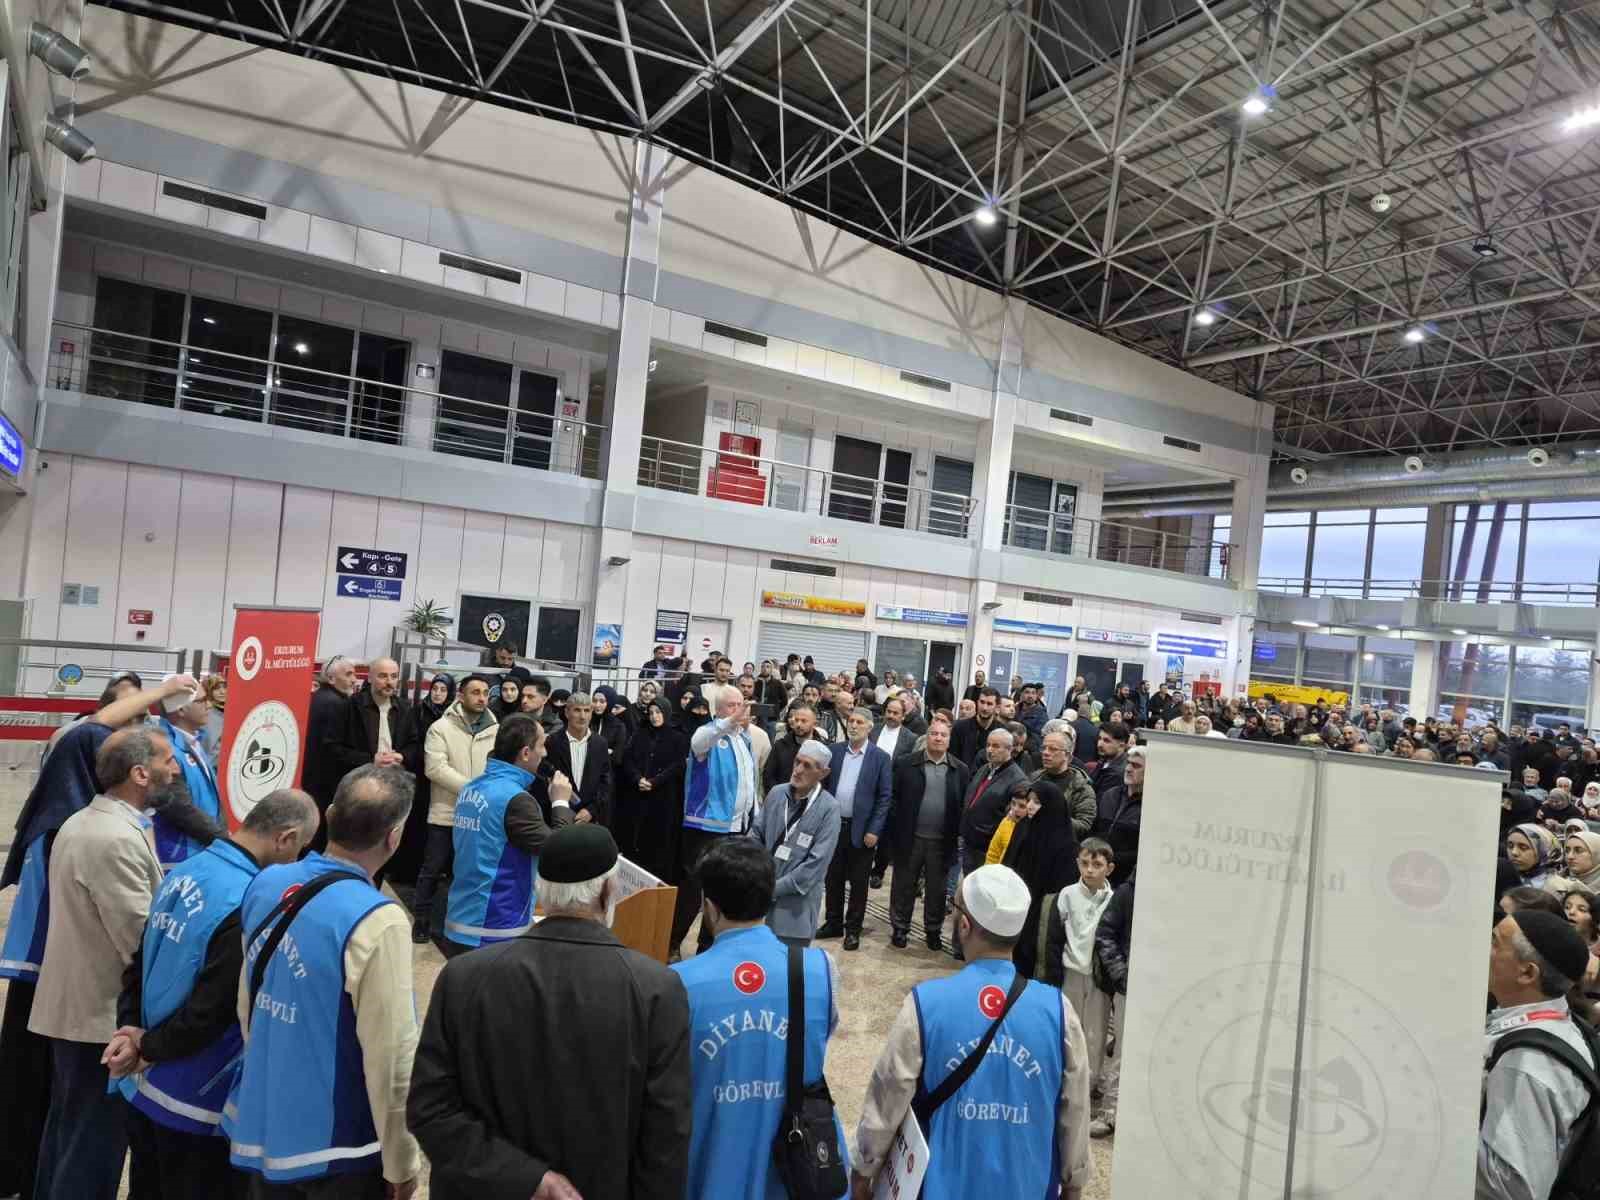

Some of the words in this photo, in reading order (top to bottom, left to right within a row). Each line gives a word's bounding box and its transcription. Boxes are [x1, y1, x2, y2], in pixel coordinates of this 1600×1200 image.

[809, 535, 838, 545] REKLAM
[699, 1009, 788, 1061] DİYANE
[713, 1080, 785, 1103] GÖREVL
